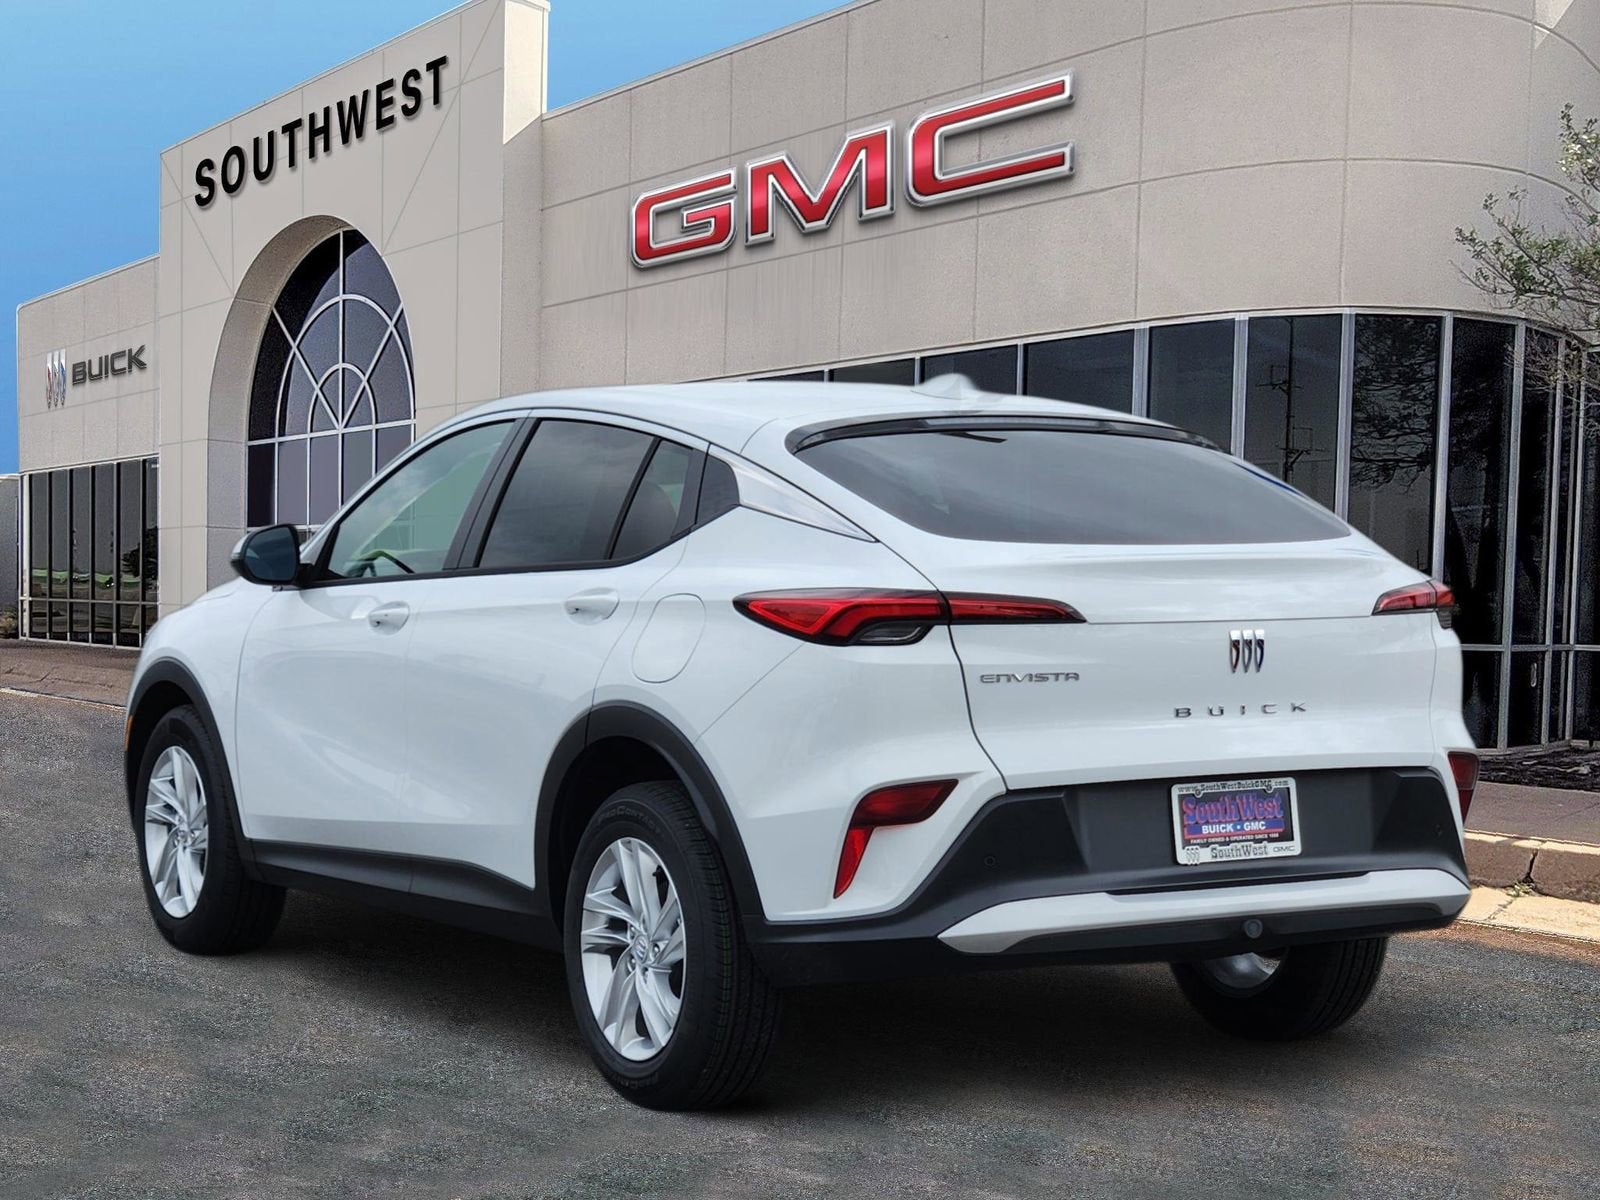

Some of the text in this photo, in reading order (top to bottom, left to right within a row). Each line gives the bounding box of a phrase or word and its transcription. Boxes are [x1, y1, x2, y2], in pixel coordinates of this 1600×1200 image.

[194, 55, 448, 208] SOUTHWEST
[630, 68, 1075, 268] GMC
[72, 345, 147, 385] BUICK
[980, 672, 1080, 684] ENVISTA
[1174, 702, 1306, 718] BUICK
[1202, 821, 1267, 834] BUICK GMC
